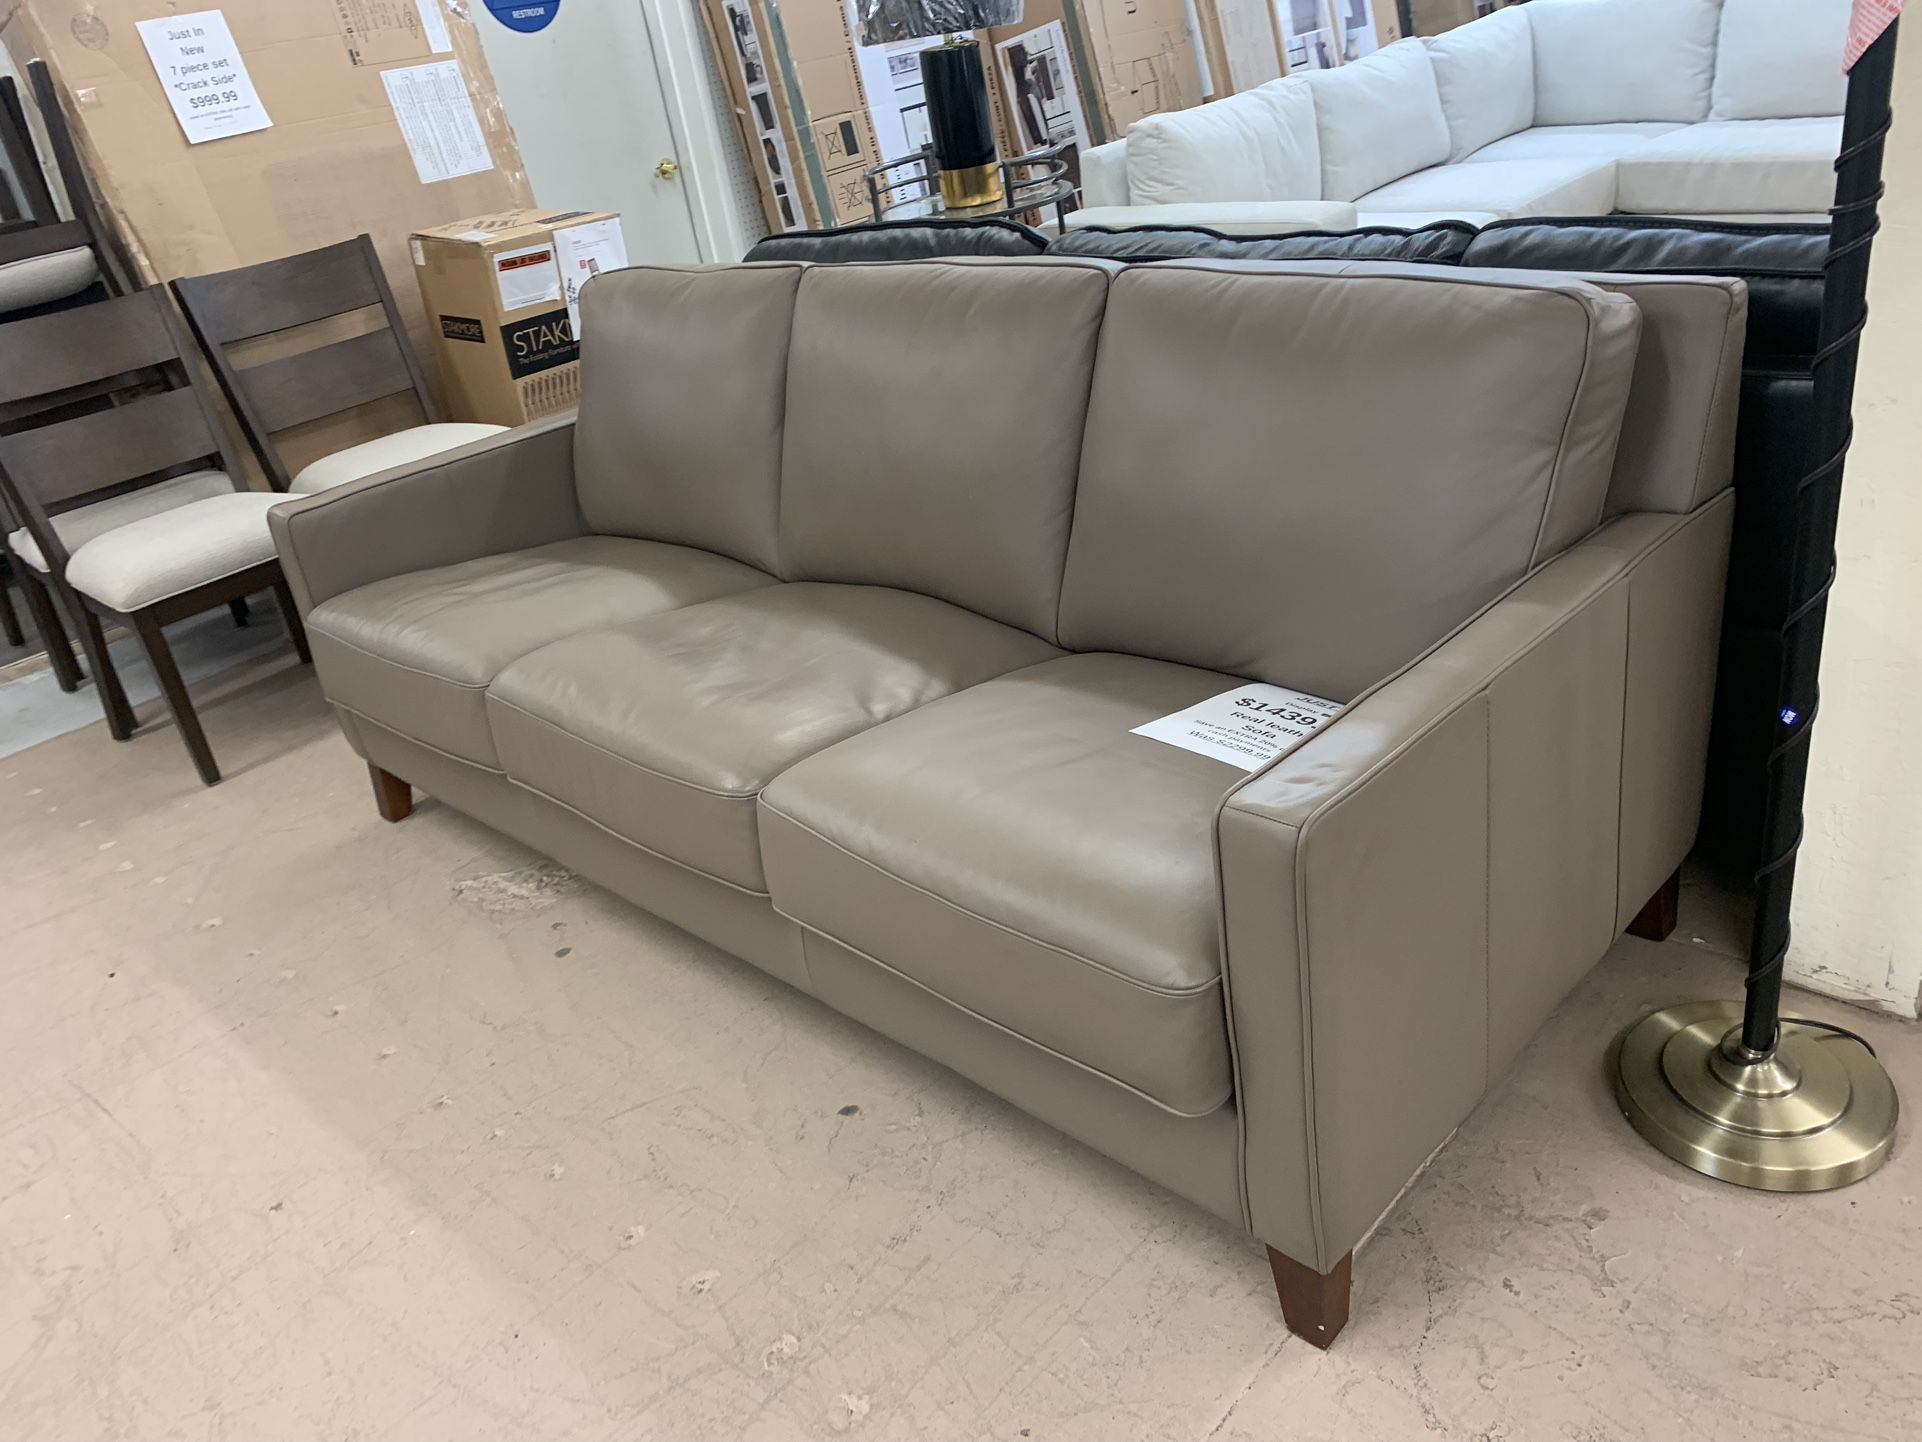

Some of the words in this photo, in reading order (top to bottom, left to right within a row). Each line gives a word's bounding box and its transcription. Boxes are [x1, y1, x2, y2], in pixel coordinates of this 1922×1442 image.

[168, 29, 191, 41] Just
[192, 27, 205, 36] In
[180, 46, 205, 56] New
[169, 66, 177, 76] 7
[180, 62, 209, 77] piece
[211, 58, 229, 69] set
[189, 90, 238, 109] $999.99
[1231, 711, 1265, 724] Real
[1189, 730, 1215, 742] Was
[1227, 729, 1258, 741] EXTRA
[1242, 725, 1277, 739] Sofa
